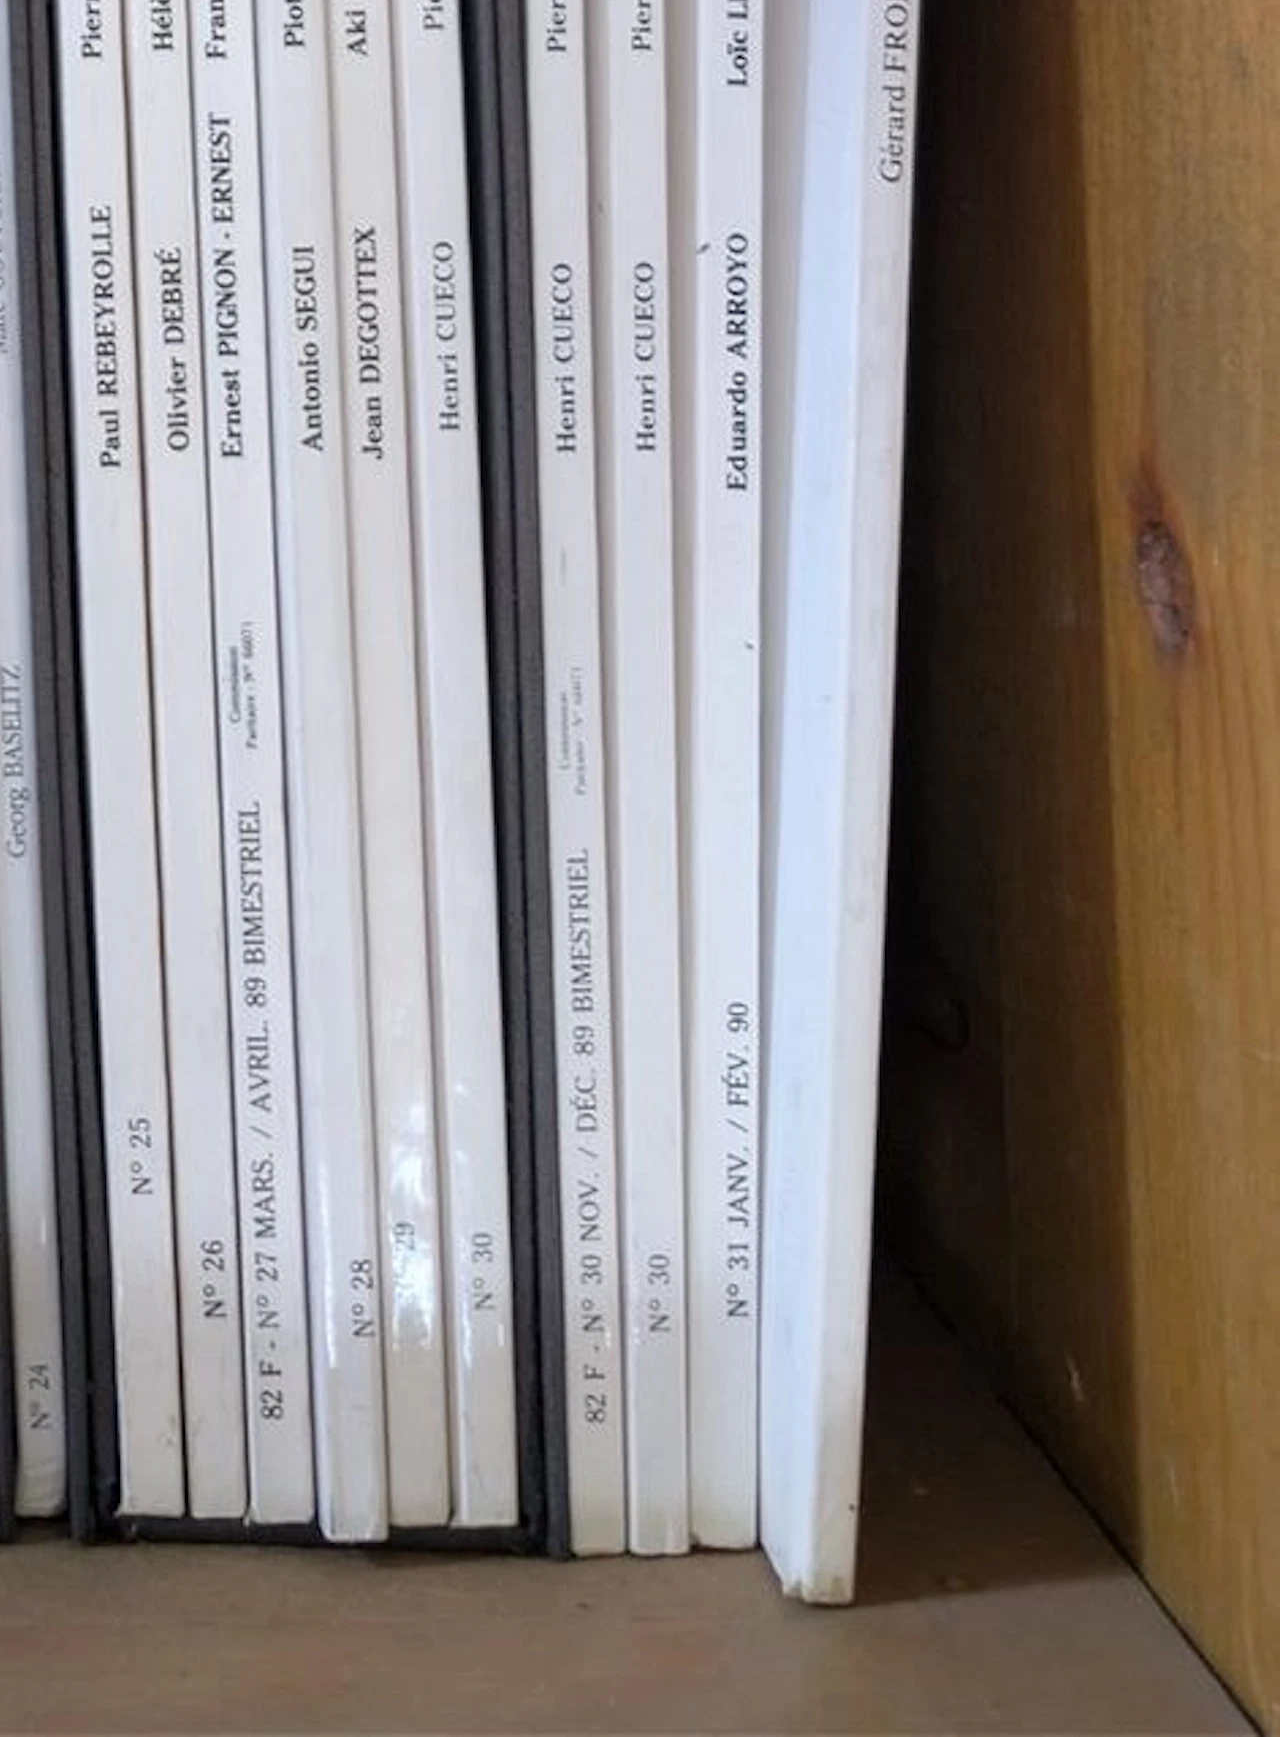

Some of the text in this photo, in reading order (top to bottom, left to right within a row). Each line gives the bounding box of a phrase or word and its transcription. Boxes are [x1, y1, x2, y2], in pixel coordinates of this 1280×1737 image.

[726, 30, 749, 87] Loïc
[879, 85, 906, 183] Gérard
[89, 205, 118, 396] REBEYROLLE
[725, 232, 748, 359] ARROYO
[97, 409, 121, 467] Paul
[725, 370, 748, 491] Eduardo
[236, 801, 266, 965] BIMESTRIEL
[242, 976, 267, 1008] 89
[254, 1251, 278, 1281] 27
[257, 1359, 282, 1377] F
[259, 1389, 284, 1420] 82
